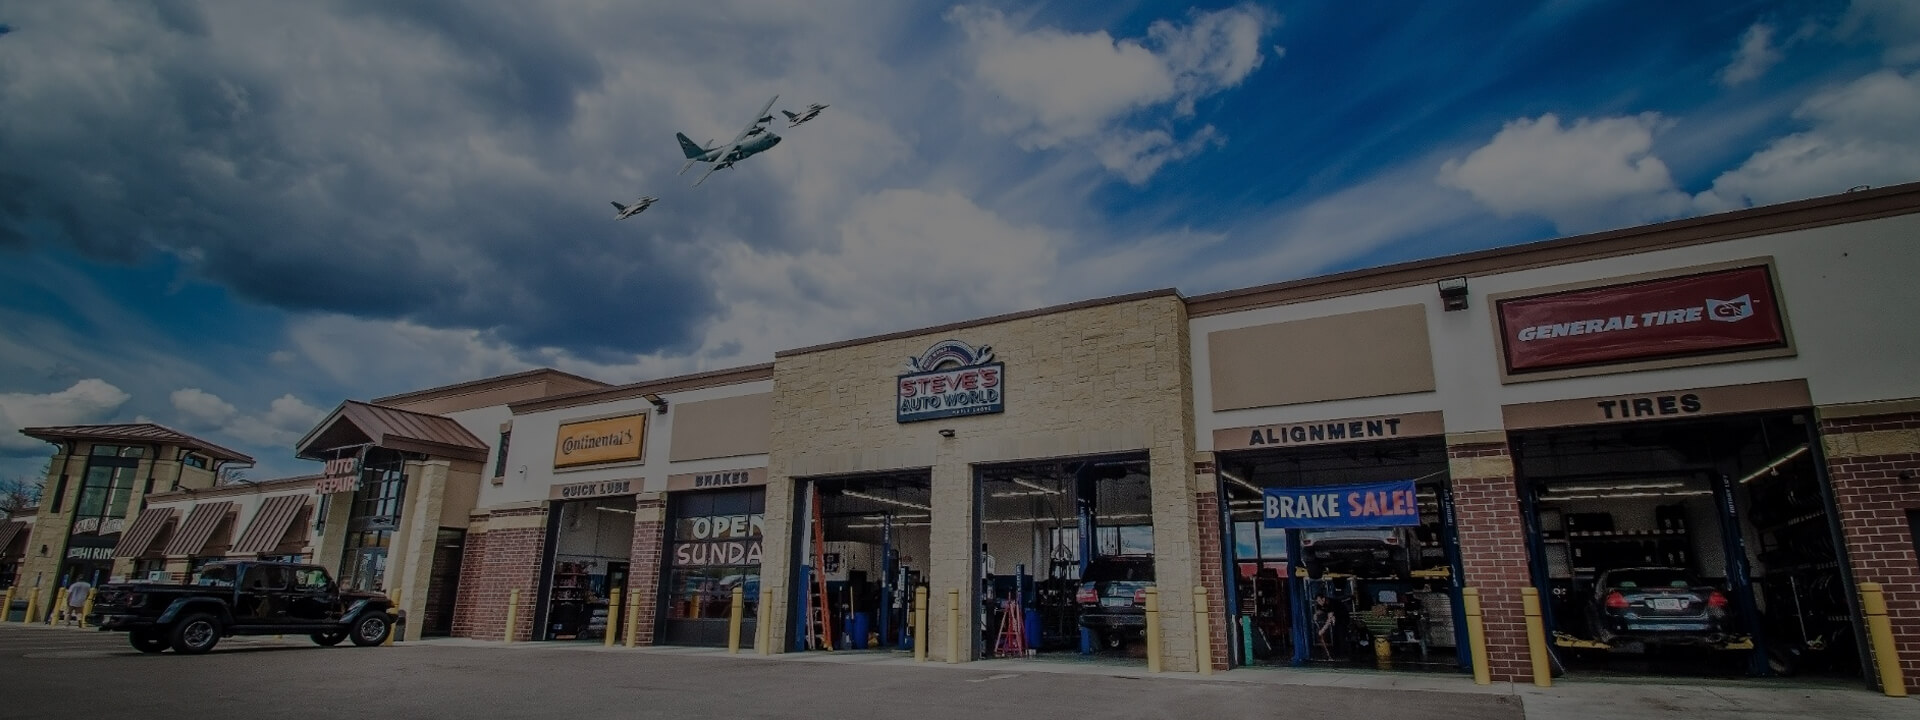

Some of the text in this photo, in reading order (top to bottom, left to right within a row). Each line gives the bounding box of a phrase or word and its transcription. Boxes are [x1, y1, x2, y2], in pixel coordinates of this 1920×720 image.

[1517, 306, 1704, 342] GENERAL TIRE
[900, 368, 999, 397] STEVE'S
[901, 388, 999, 413] AUTO WORLD
[1598, 394, 1702, 419] TIRES
[562, 431, 624, 455] Continental
[1250, 418, 1401, 446] ALIGNMENT
[326, 458, 353, 474] AUTO
[315, 476, 356, 494] REPAIR
[562, 481, 631, 497] QUICK LUBE
[695, 472, 749, 487] BRAKES
[1266, 490, 1414, 519] BRAKE SALE!
[692, 513, 764, 540] OPEN
[80, 547, 113, 560] HIRIN
[677, 541, 762, 566] SUNDA
